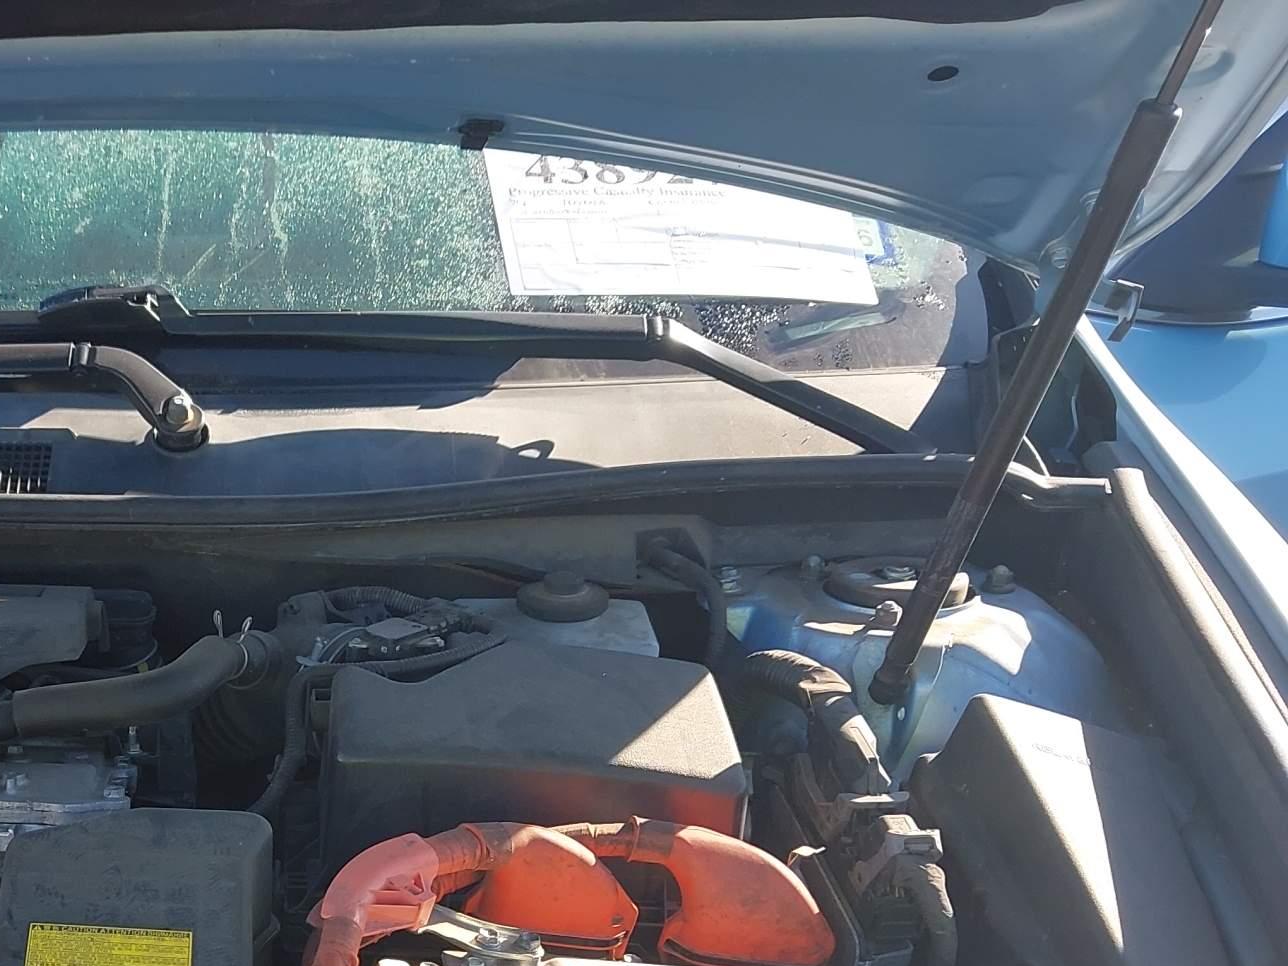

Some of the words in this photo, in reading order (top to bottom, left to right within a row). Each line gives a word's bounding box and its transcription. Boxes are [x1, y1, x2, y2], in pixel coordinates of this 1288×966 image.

[508, 186, 589, 198] Progressive
[593, 186, 655, 199] Casualty
[658, 186, 728, 198] Insurance
[62, 925, 98, 933] CAUTION
[100, 927, 147, 936] ATTENTION
